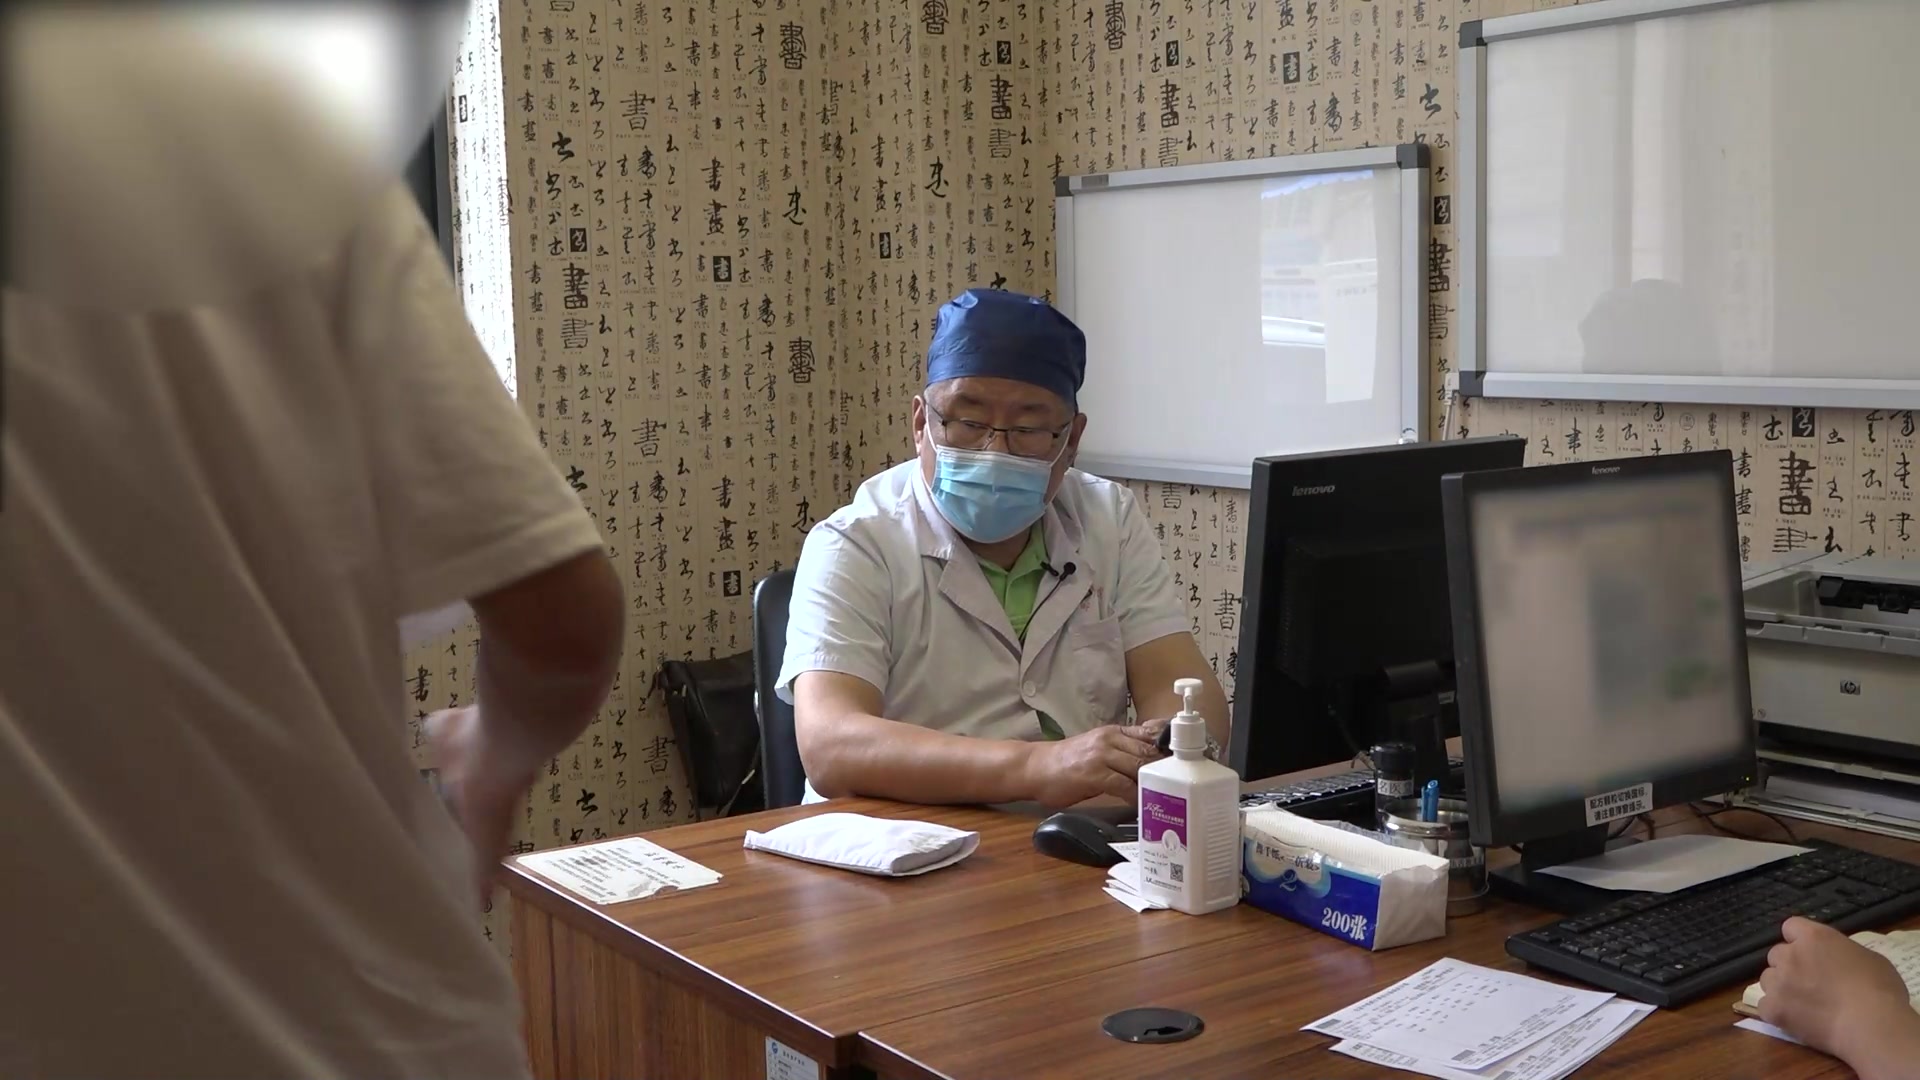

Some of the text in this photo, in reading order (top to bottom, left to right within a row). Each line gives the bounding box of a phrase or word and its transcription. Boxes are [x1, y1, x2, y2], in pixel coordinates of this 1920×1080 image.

[1591, 465, 1621, 475] lenovo
[1291, 484, 1336, 497] lenovo
[1280, 869, 1298, 892] 2
[1321, 907, 1368, 941] 200张
